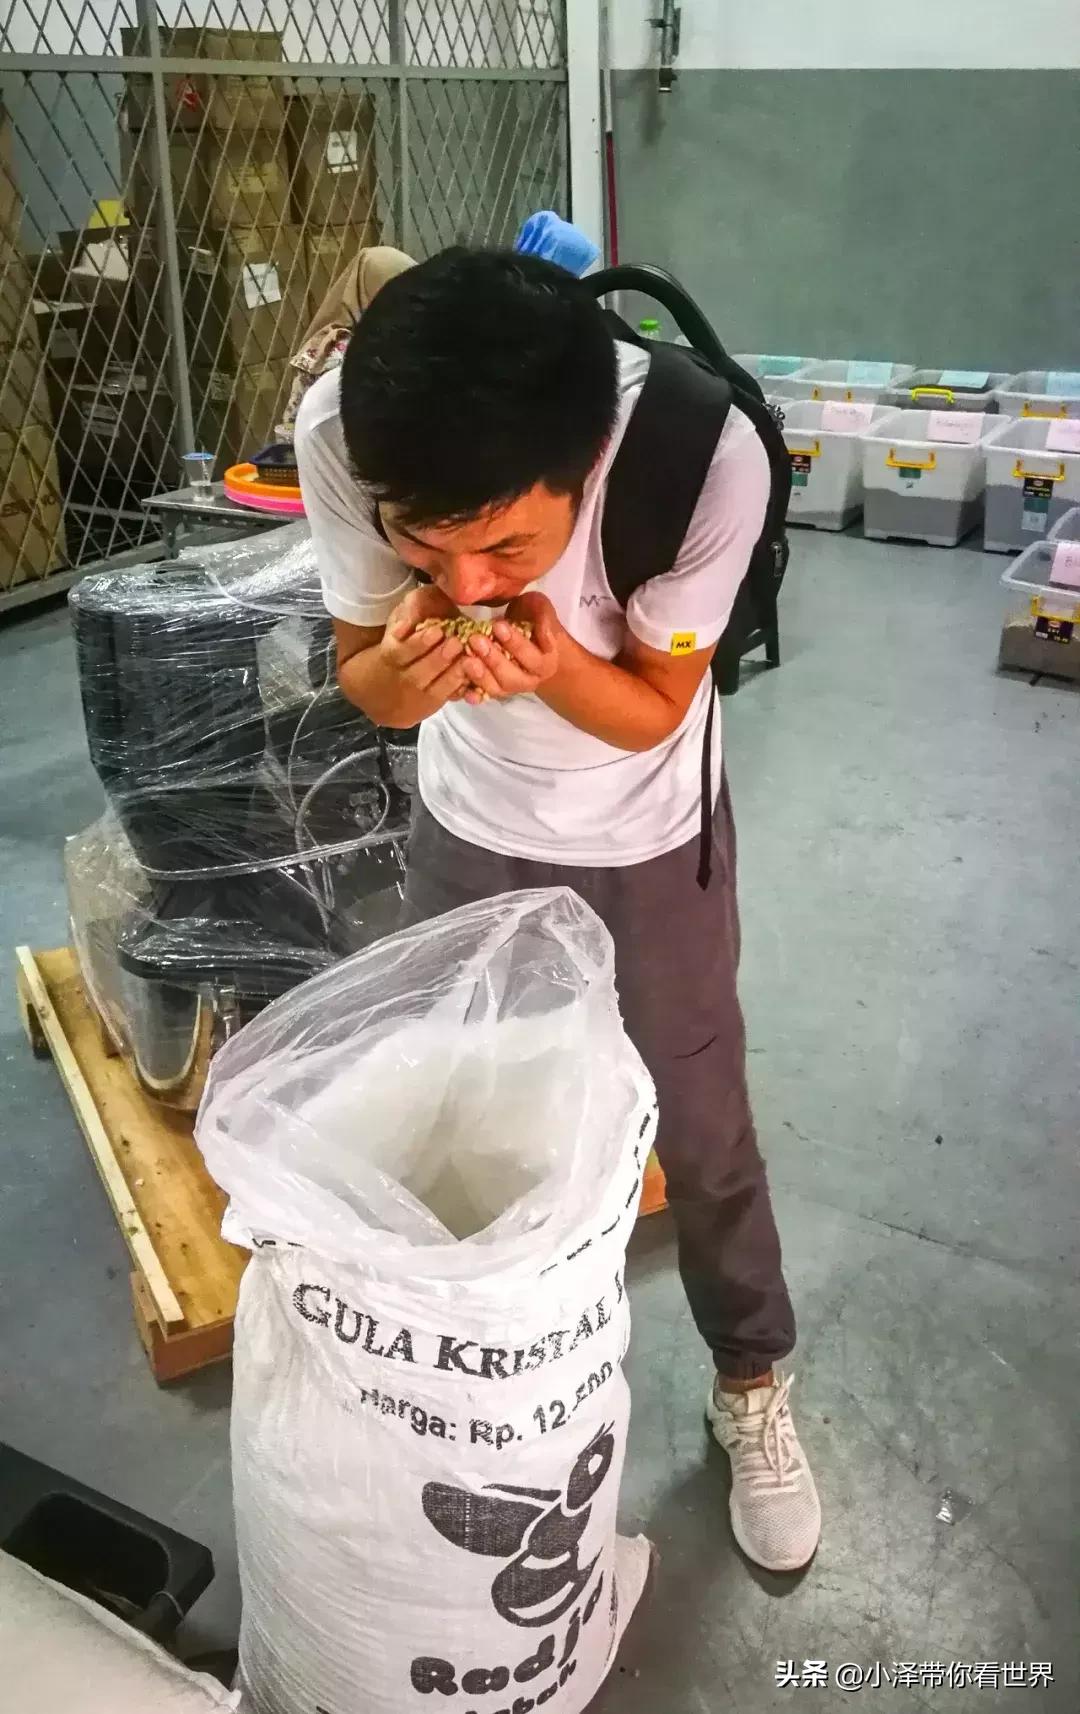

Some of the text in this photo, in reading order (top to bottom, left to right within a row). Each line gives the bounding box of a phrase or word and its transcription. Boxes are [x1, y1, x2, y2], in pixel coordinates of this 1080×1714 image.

[675, 641, 692, 649] MX
[292, 1282, 611, 1380] GULA KRISTAL
[360, 1388, 457, 1441] Harga:
[469, 1418, 523, 1450] Rp.
